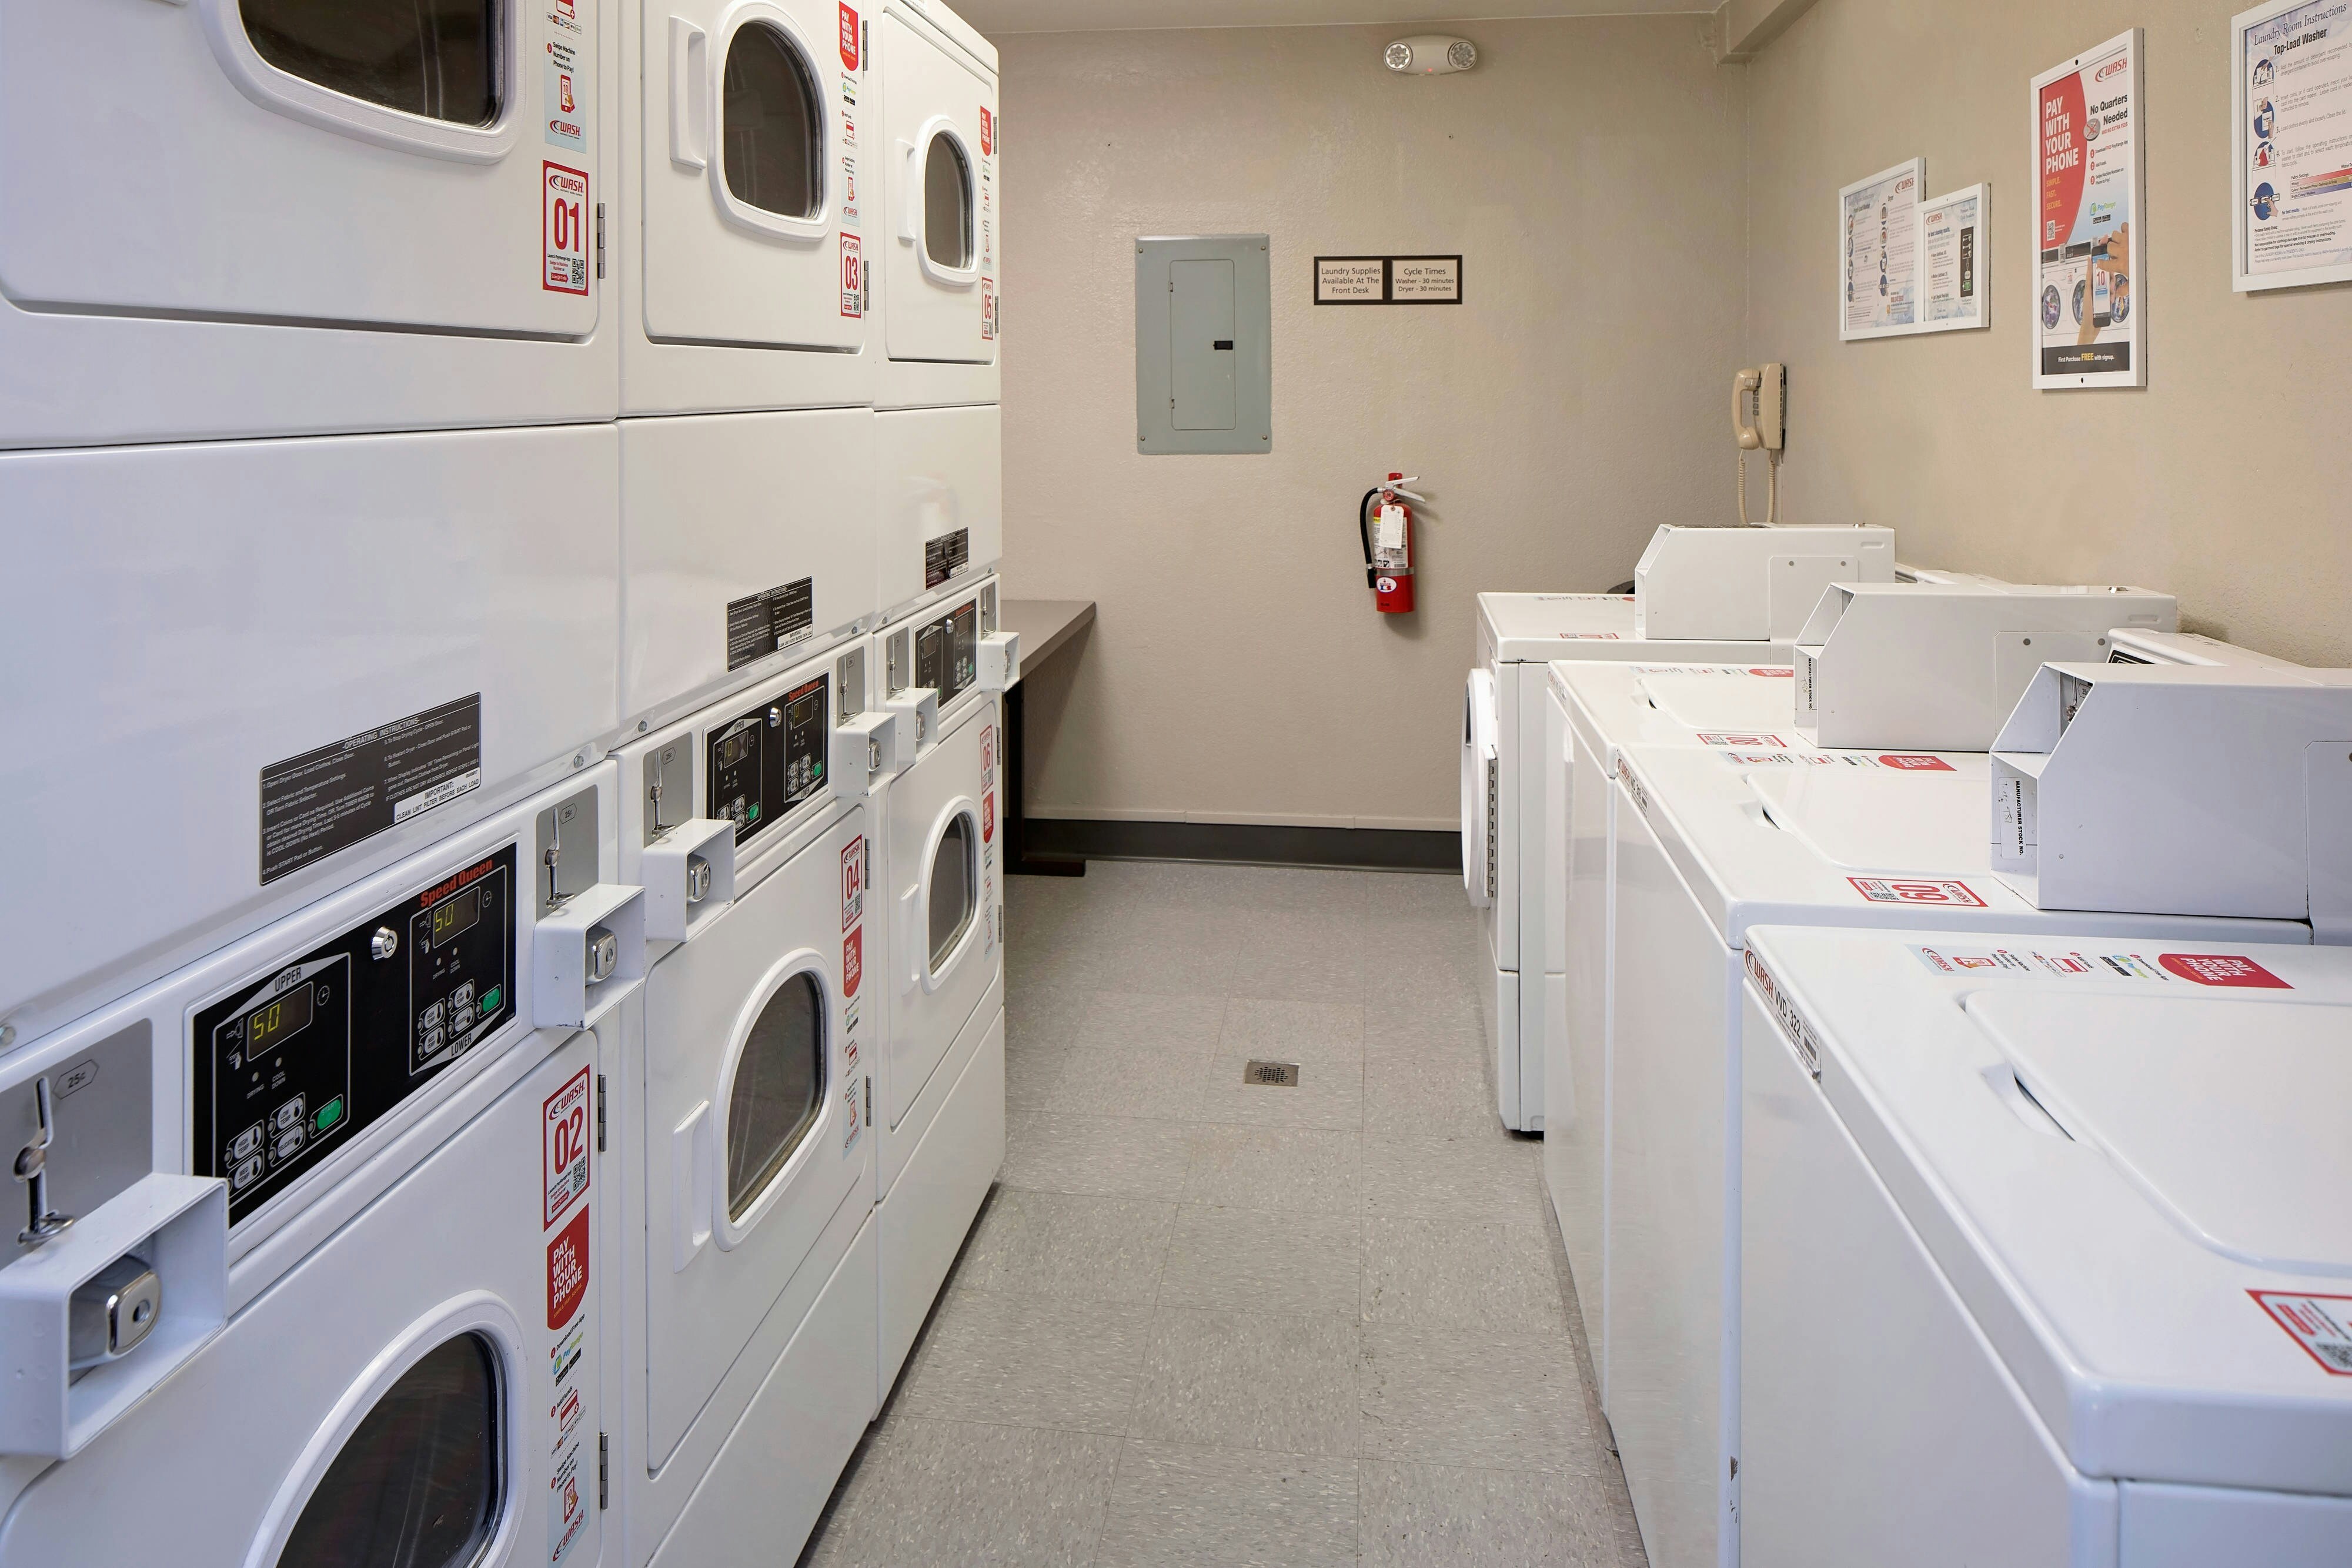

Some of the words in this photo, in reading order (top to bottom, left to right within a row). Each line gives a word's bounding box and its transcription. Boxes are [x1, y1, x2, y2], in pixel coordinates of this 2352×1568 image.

[841, 19, 852, 34] WITH
[2254, 31, 2281, 46] Laundry
[2283, 21, 2302, 35] Room
[2304, 4, 2347, 27] Instructions
[841, 29, 853, 44] YOUR
[2274, 37, 2300, 56] Top-Load
[2302, 28, 2327, 45] Washer
[553, 42, 562, 51] Swipe
[563, 46, 576, 55] Machine
[553, 51, 566, 60] Number
[842, 39, 856, 55] PHONE
[553, 60, 563, 69] Phone
[2105, 58, 2127, 76] WASH
[2046, 96, 2063, 119] PAY
[2090, 104, 2099, 115] No
[2100, 94, 2127, 111] Quarters
[2046, 112, 2070, 137] WITH
[2103, 108, 2128, 125] Needed
[560, 122, 580, 136] WASH
[2112, 123, 2120, 132] EXTRA
[2046, 132, 2071, 156] YOUR
[2046, 148, 2079, 175] PHONE
[560, 177, 583, 193] WASH
[2046, 176, 2061, 188] SIMPLE.
[2046, 189, 2057, 198] FAST.
[2046, 200, 2062, 210] SECURE.
[554, 198, 579, 252] 01
[848, 241, 858, 250] WASH
[846, 256, 858, 290] 03
[1321, 268, 1349, 276] Laundry
[2097, 270, 2105, 287] 10
[984, 294, 991, 319] 05
[2082, 353, 2094, 361] FREE
[789, 687, 804, 701] Speed
[805, 680, 818, 693] Queen
[1724, 737, 1764, 745] 08
[983, 743, 990, 771] 06
[425, 780, 454, 800] IMPORTANT:
[801, 787, 810, 798] LOWER
[396, 808, 410, 821] CLEAN
[413, 803, 422, 813] LINT
[424, 797, 437, 808] FILTER
[439, 788, 455, 801] BEFORE
[456, 783, 467, 793] EACH
[469, 778, 479, 788] LOAD
[849, 843, 860, 858] WASH
[420, 875, 456, 908] Speed
[459, 859, 493, 887] Queen
[847, 859, 860, 900] 04
[1890, 884, 1950, 902] 09
[1951, 890, 1973, 903] WASH
[435, 903, 454, 933] 50
[846, 947, 856, 961] WITH
[450, 959, 460, 968] COOL
[450, 964, 460, 974] DOWN
[846, 957, 857, 973] YOUR
[1931, 955, 1955, 971] WASH
[2127, 962, 2149, 978] PayRange
[2136, 958, 2153, 970] Download
[2180, 958, 2224, 981] PHONE
[2197, 959, 2231, 977] YOUR
[2212, 959, 2247, 977] WITH
[2227, 959, 2257, 973] PAY
[275, 967, 302, 992] UPPER
[433, 968, 445, 979] DRYING
[846, 962, 859, 983] PHONE
[1753, 955, 1774, 998] WASH
[1790, 1010, 1800, 1039] 322
[254, 1003, 281, 1041] 50
[451, 1037, 472, 1057] LOWER
[68, 1071, 86, 1089] 25¢
[271, 1077, 286, 1089] DOWN
[272, 1071, 286, 1082] COOL
[246, 1084, 265, 1099] DRYING
[561, 1079, 584, 1109] WASH
[280, 1109, 289, 1119] LOW
[321, 1102, 335, 1115] START
[280, 1115, 291, 1125] TEMP
[238, 1138, 248, 1147] HIGH
[238, 1142, 249, 1154] TEMP
[555, 1106, 583, 1175] 02
[238, 1171, 250, 1183] TEMP
[239, 1167, 249, 1176] MED
[553, 1236, 569, 1264] PAY
[553, 1244, 575, 1279] WITH
[553, 1259, 576, 1293] YOUR
[553, 1265, 582, 1309] PHONE
[556, 1329, 572, 1351] Download
[563, 1332, 583, 1360] PayRange
[563, 1386, 573, 1399] Funds
[557, 1457, 567, 1475] Swipe
[566, 1442, 580, 1463] Machine
[557, 1466, 570, 1484] Number
[569, 1458, 574, 1467] on
[557, 1476, 567, 1493] Phone
[563, 1509, 584, 1546] WASH
